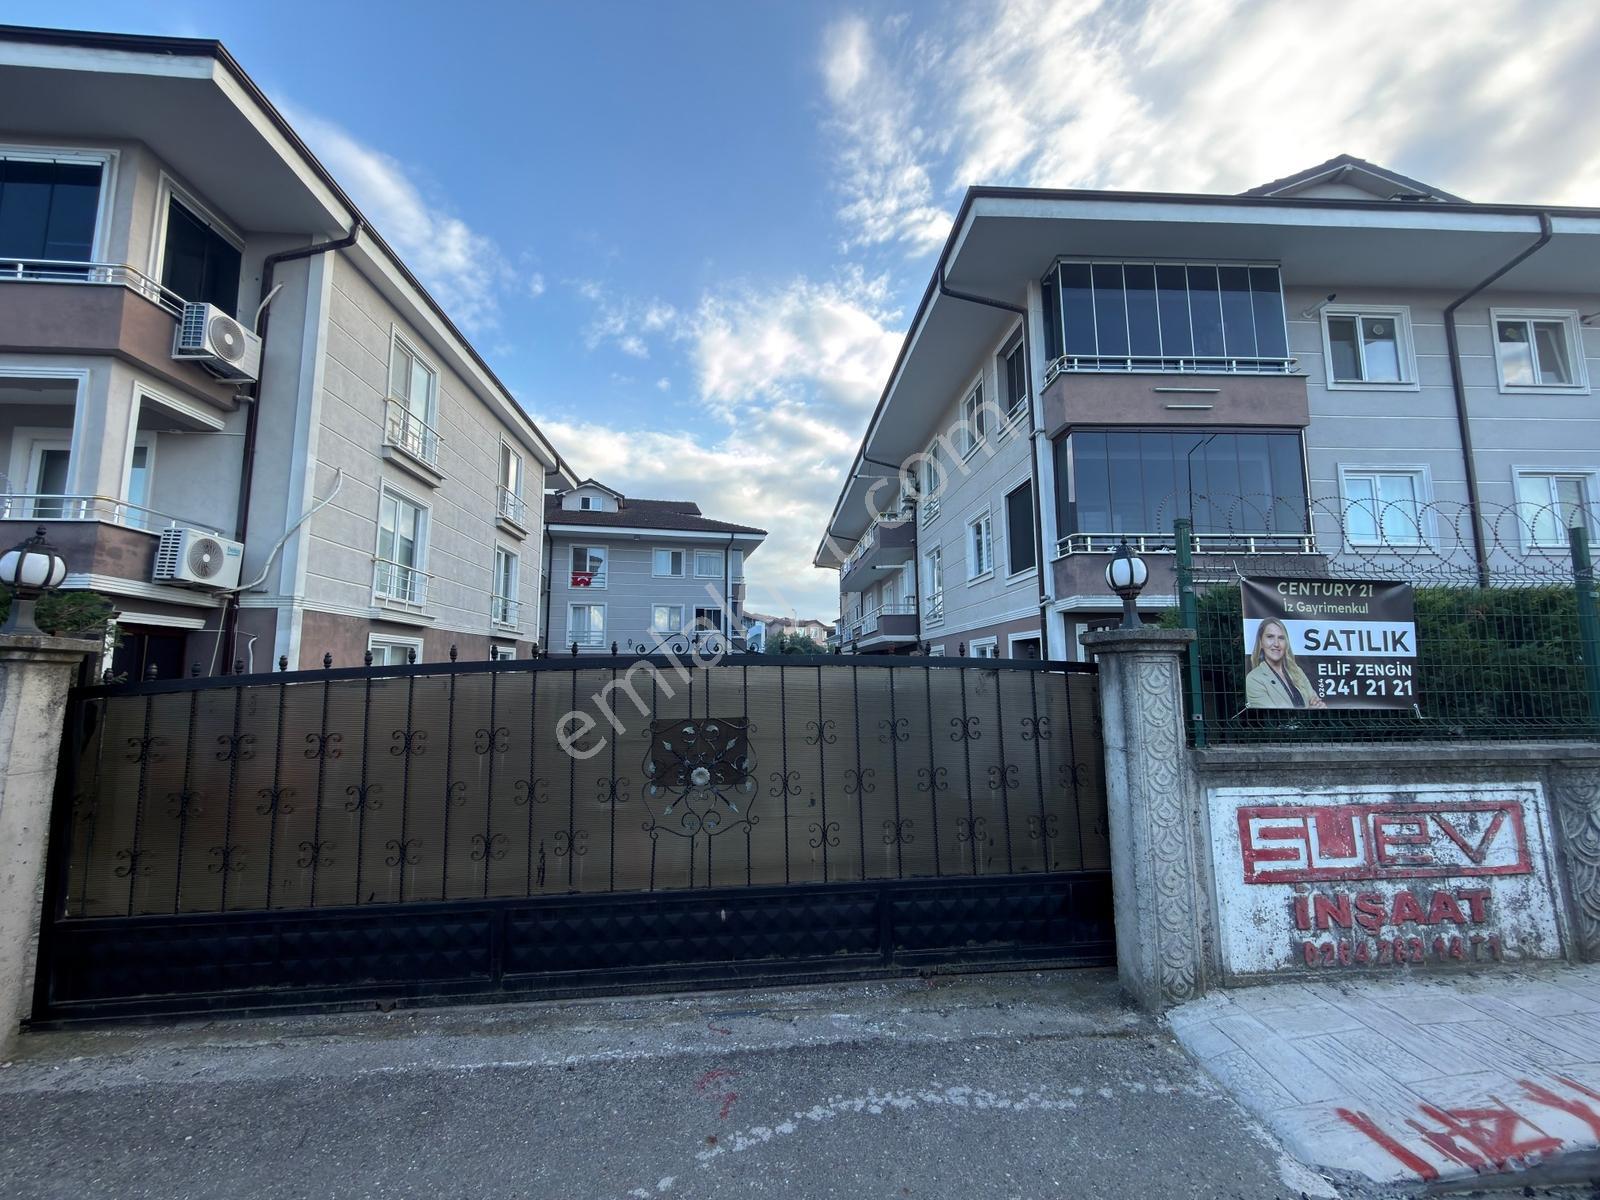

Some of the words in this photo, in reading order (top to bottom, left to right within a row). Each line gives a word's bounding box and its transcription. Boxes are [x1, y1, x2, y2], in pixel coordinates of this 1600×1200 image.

[1277, 582, 1356, 597] CENTURY
[1359, 584, 1373, 598] 21
[1283, 598, 1294, 612] İz
[1296, 601, 1369, 615] Gayrimenkul
[1303, 628, 1410, 652] SATILIK
[1318, 660, 1351, 676] ELİF
[1355, 661, 1412, 677] ZENGİN
[1317, 678, 1325, 698] 0264
[1325, 679, 1358, 696] 241
[1366, 679, 1386, 696] 21
[1392, 679, 1413, 696] 21
